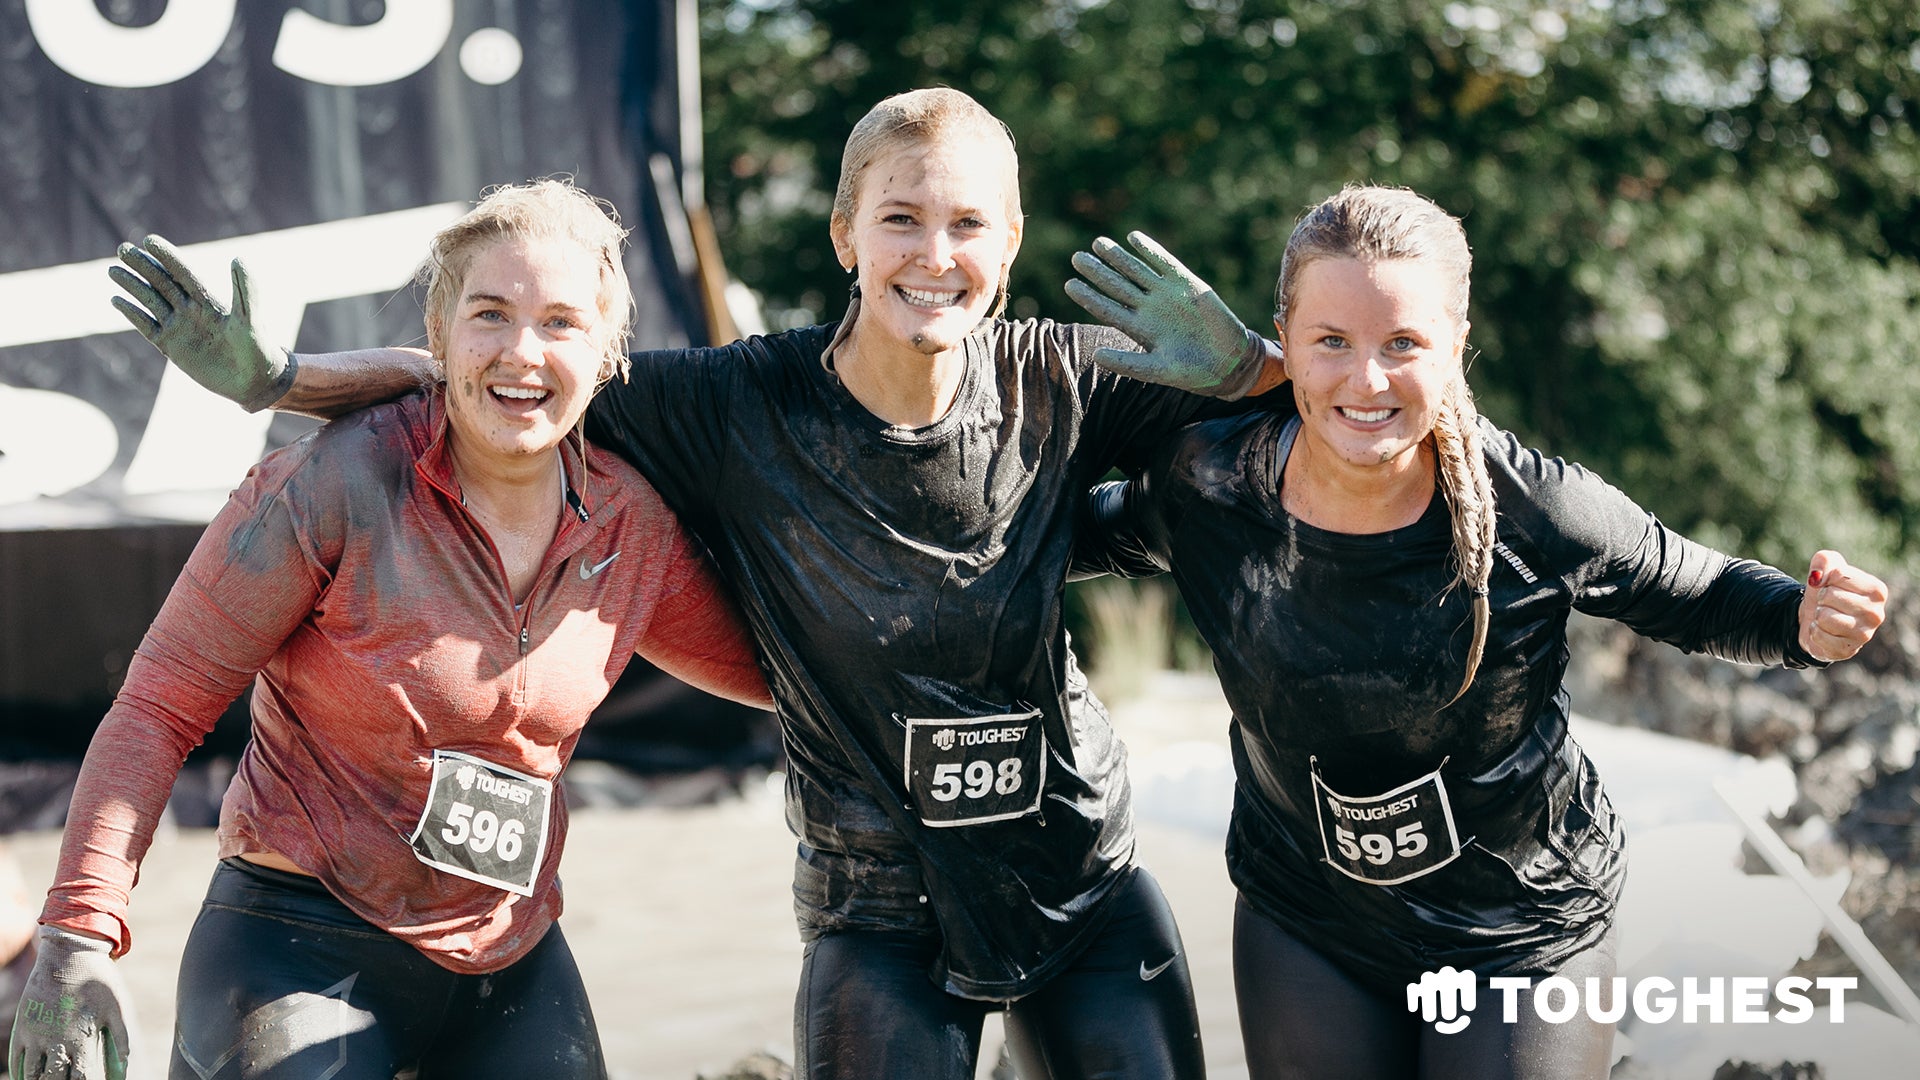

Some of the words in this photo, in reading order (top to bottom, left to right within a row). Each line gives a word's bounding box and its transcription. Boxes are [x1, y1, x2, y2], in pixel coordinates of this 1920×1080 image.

[1494, 541, 1538, 584] KARHU
[958, 726, 1028, 746] TOUGHEST
[476, 773, 533, 806] TOUGHEST
[930, 757, 1022, 802] 598
[1341, 794, 1418, 821] TOUGHEST
[441, 801, 525, 862] 596
[1335, 821, 1428, 866] 595
